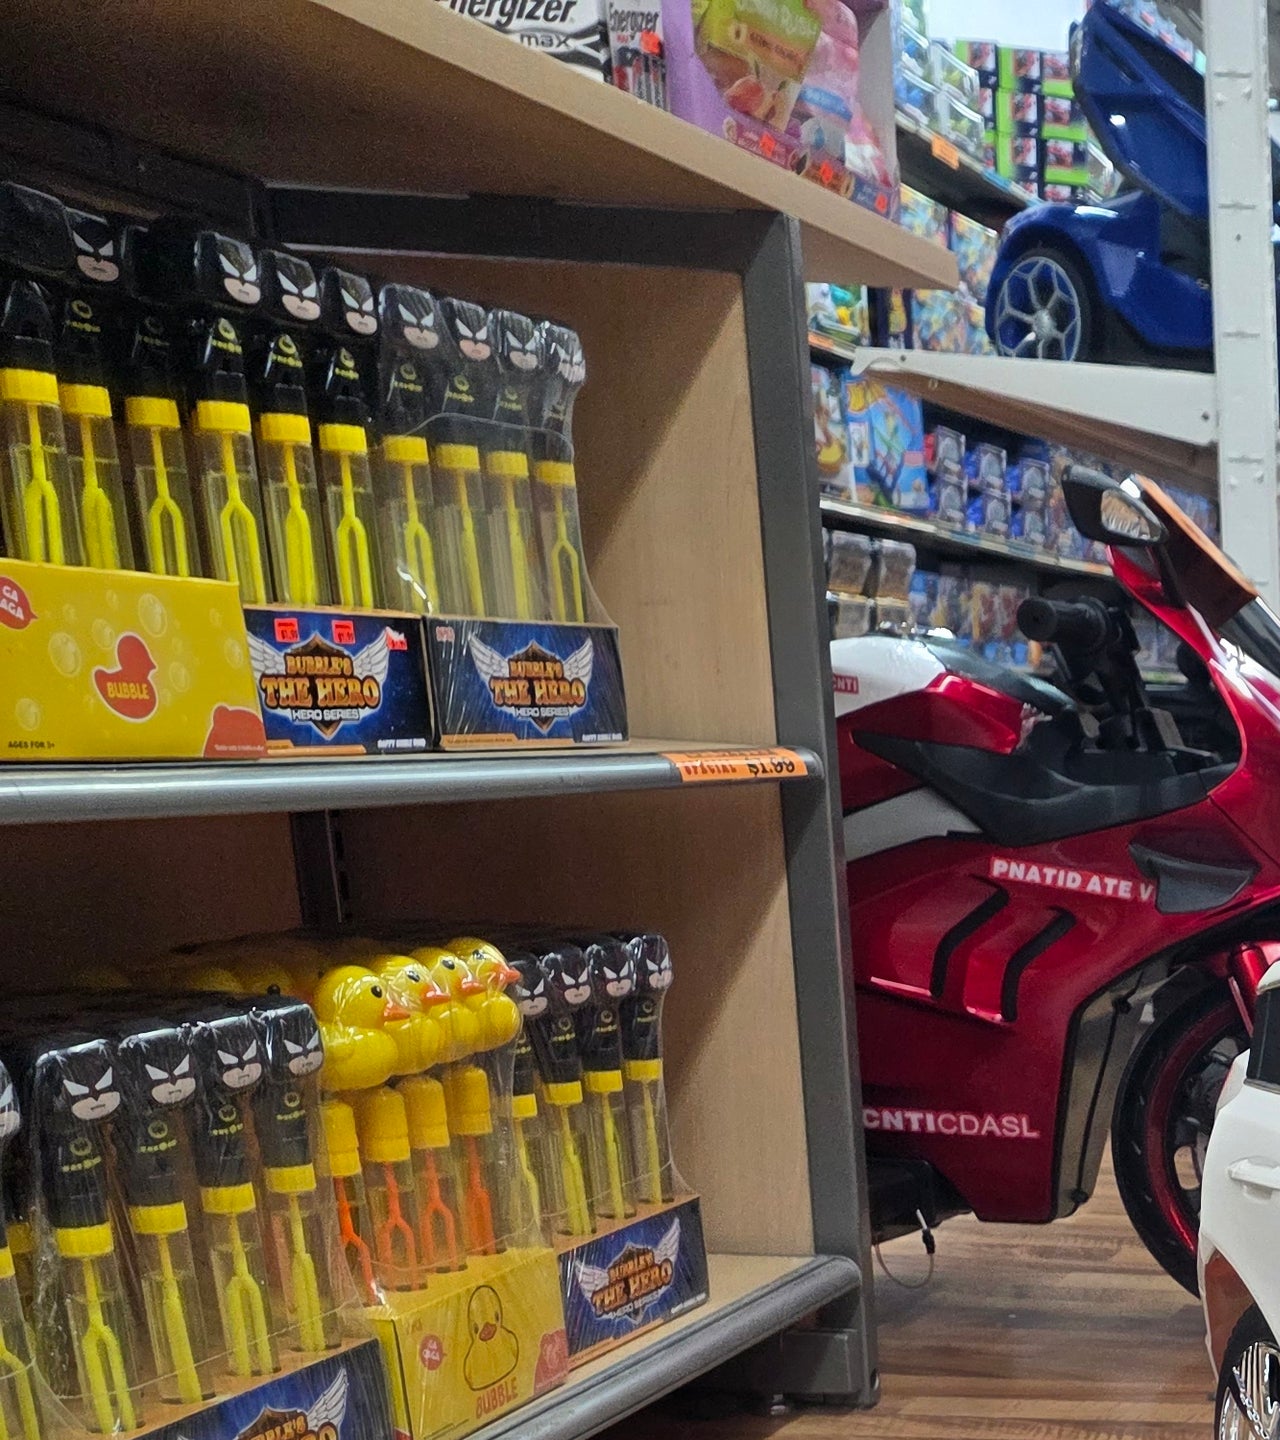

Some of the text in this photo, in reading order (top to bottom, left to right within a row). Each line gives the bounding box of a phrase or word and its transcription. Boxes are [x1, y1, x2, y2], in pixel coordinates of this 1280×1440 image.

[437, 0, 576, 27] nergizer
[609, 4, 660, 38] Energizer
[0, 598, 25, 621] AGA
[106, 681, 151, 700] BUBBLE
[261, 676, 380, 708] THE HERO
[490, 678, 586, 706] THE HERO
[291, 708, 360, 721] HERO SERIES
[541, 706, 570, 718] SERIES
[8, 740, 29, 749] AGES
[30, 740, 46, 749] FOR
[992, 858, 1082, 889] PNATID
[1086, 874, 1133, 899] ATE
[592, 1281, 629, 1316] THE
[629, 1259, 673, 1299] HERO
[475, 1376, 519, 1420] BUBBLE
